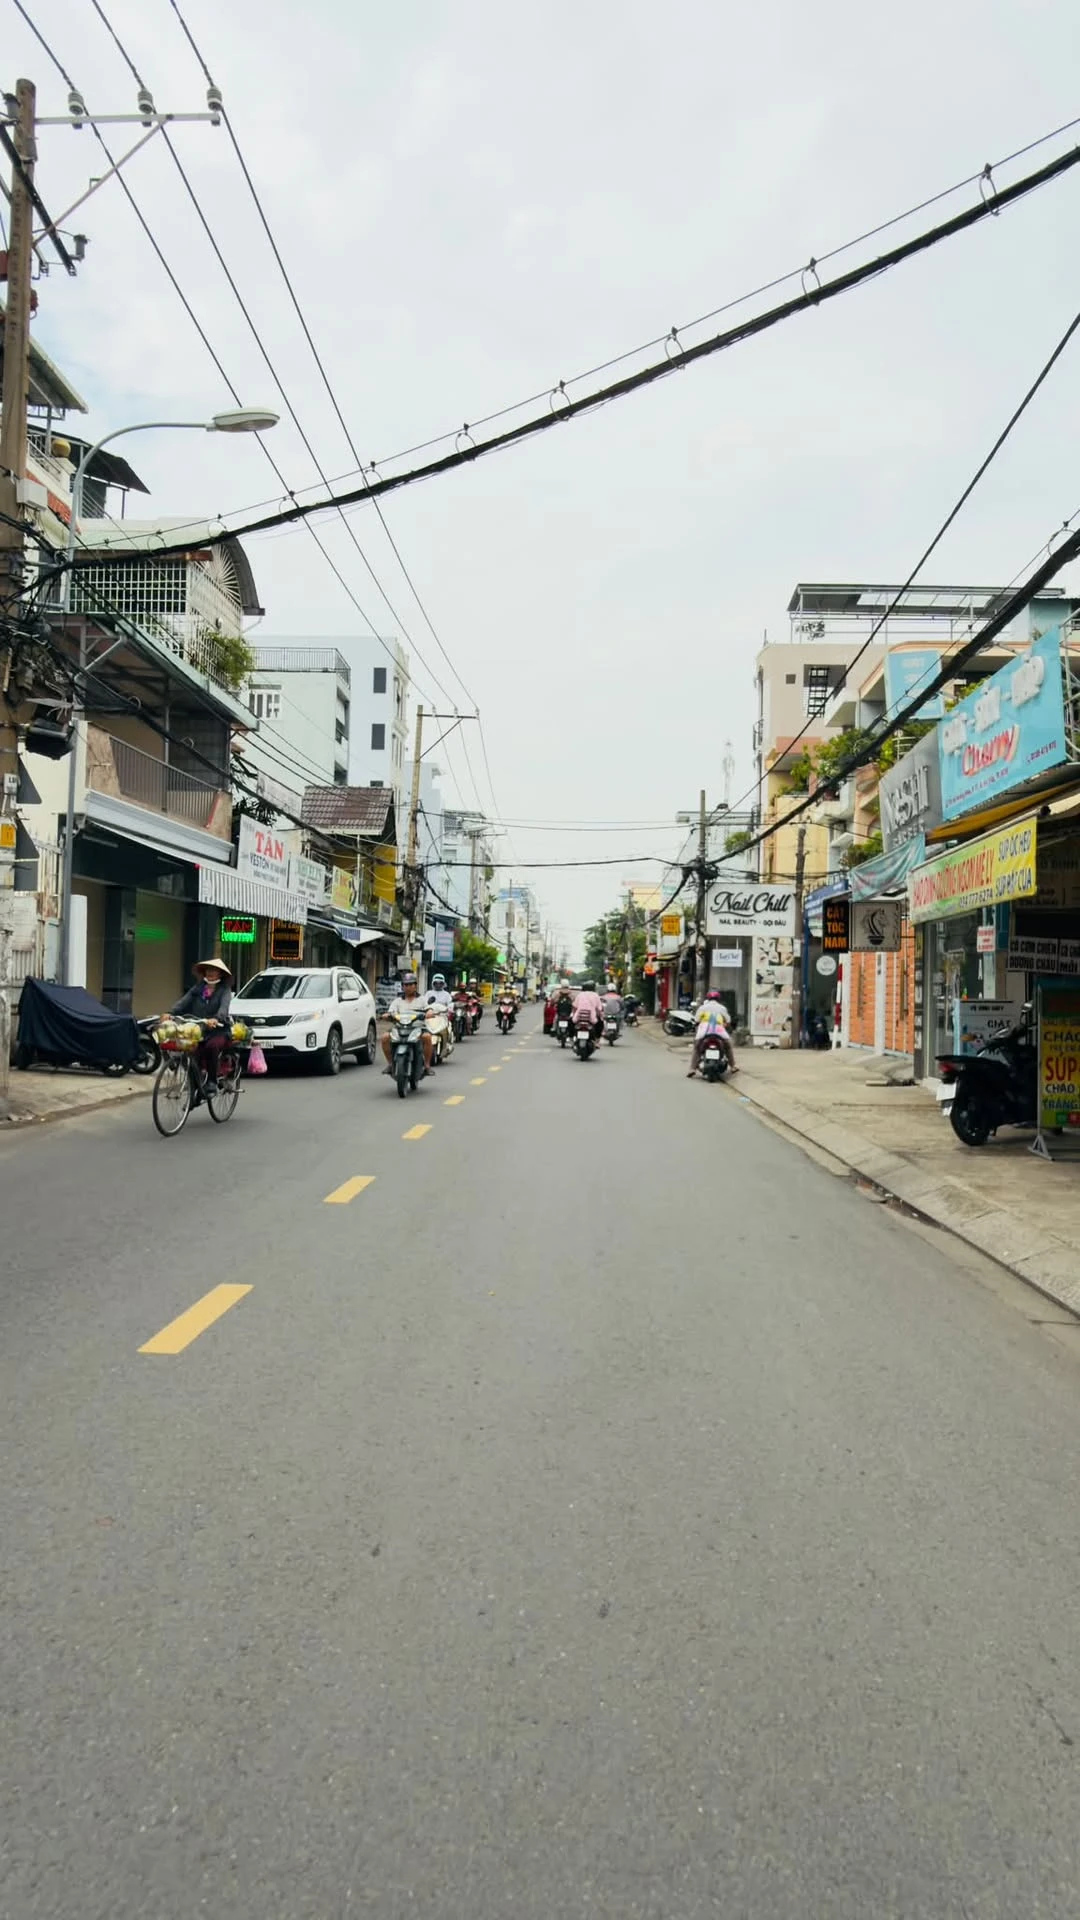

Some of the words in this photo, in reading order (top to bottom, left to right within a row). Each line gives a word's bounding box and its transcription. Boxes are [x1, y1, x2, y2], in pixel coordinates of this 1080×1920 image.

[963, 723, 1020, 777] Cherry
[255, 830, 284, 862] TÂN
[710, 891, 752, 917] Nail
[753, 892, 792, 912] Chill
[824, 937, 847, 949] NAM
[1045, 1051, 1078, 1081] SÚP
